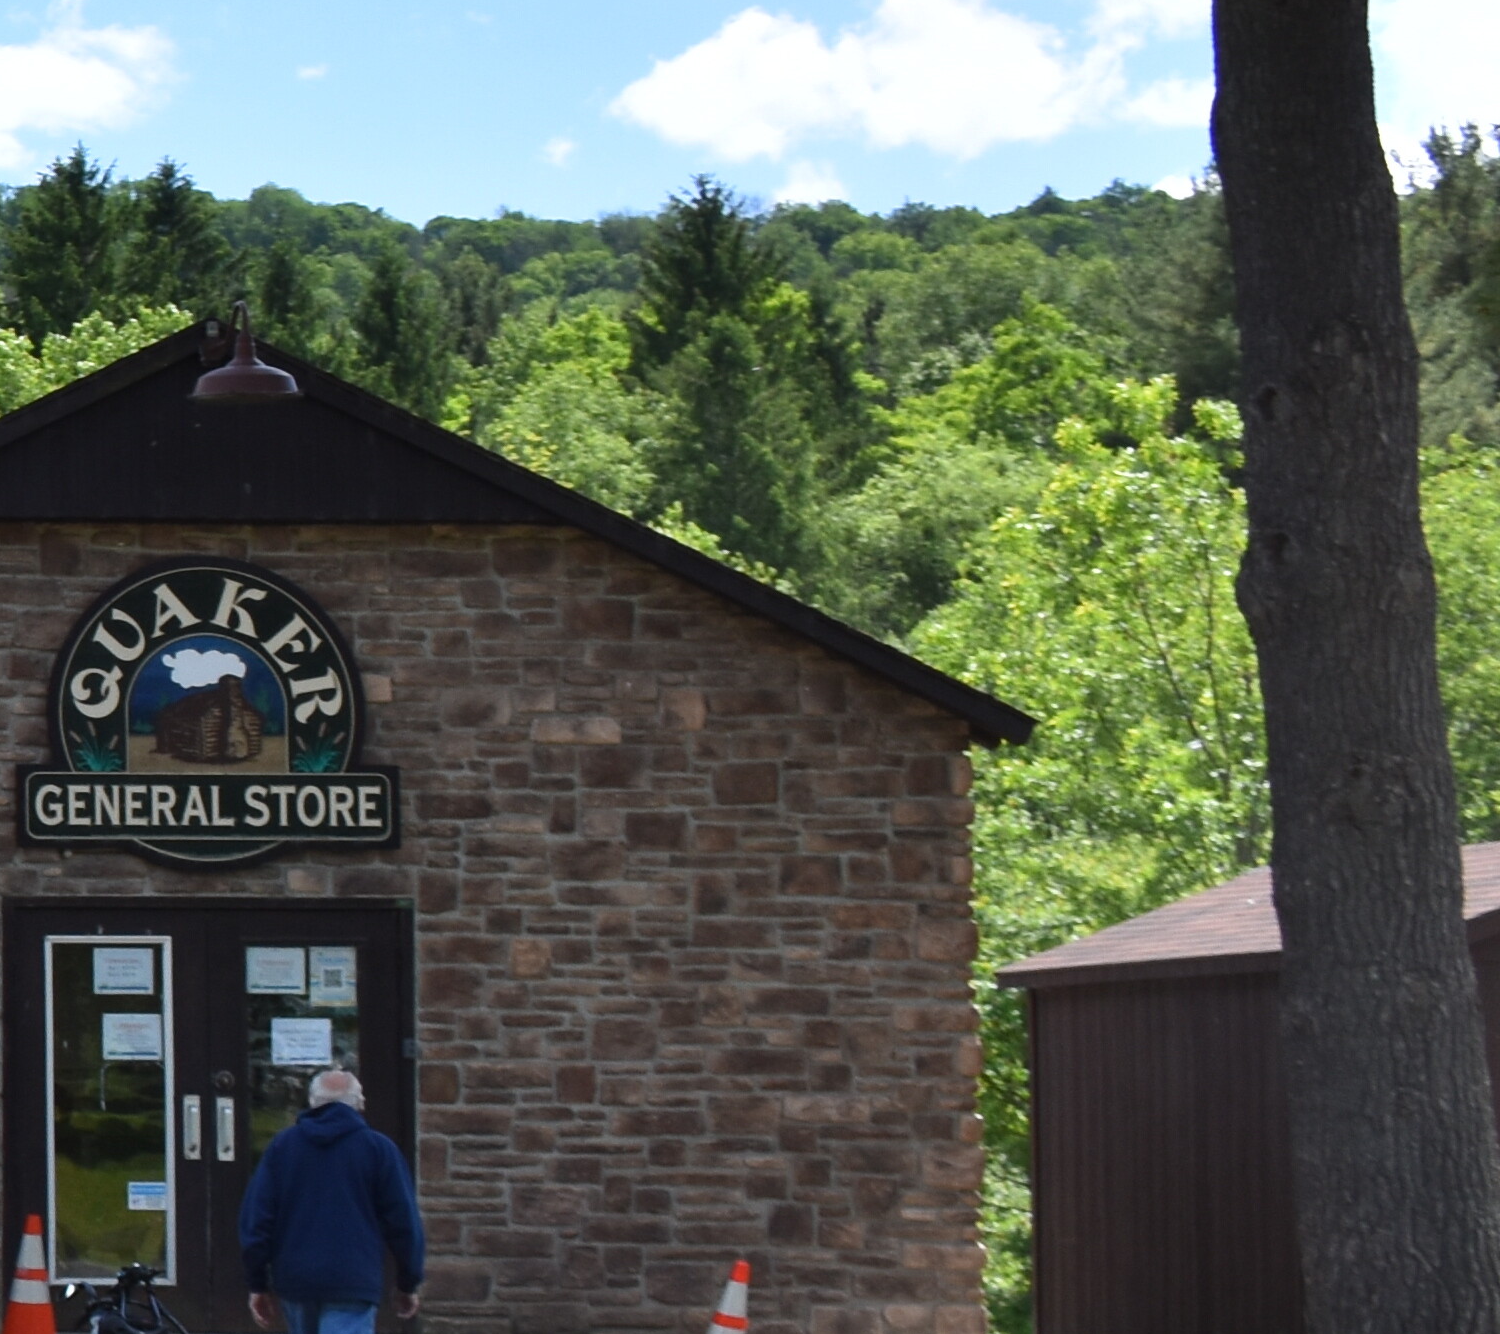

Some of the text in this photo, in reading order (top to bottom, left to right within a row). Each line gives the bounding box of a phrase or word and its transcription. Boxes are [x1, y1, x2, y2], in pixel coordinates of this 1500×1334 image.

[70, 578, 343, 725] QUAKER
[34, 783, 382, 827] GENERAL STORE
